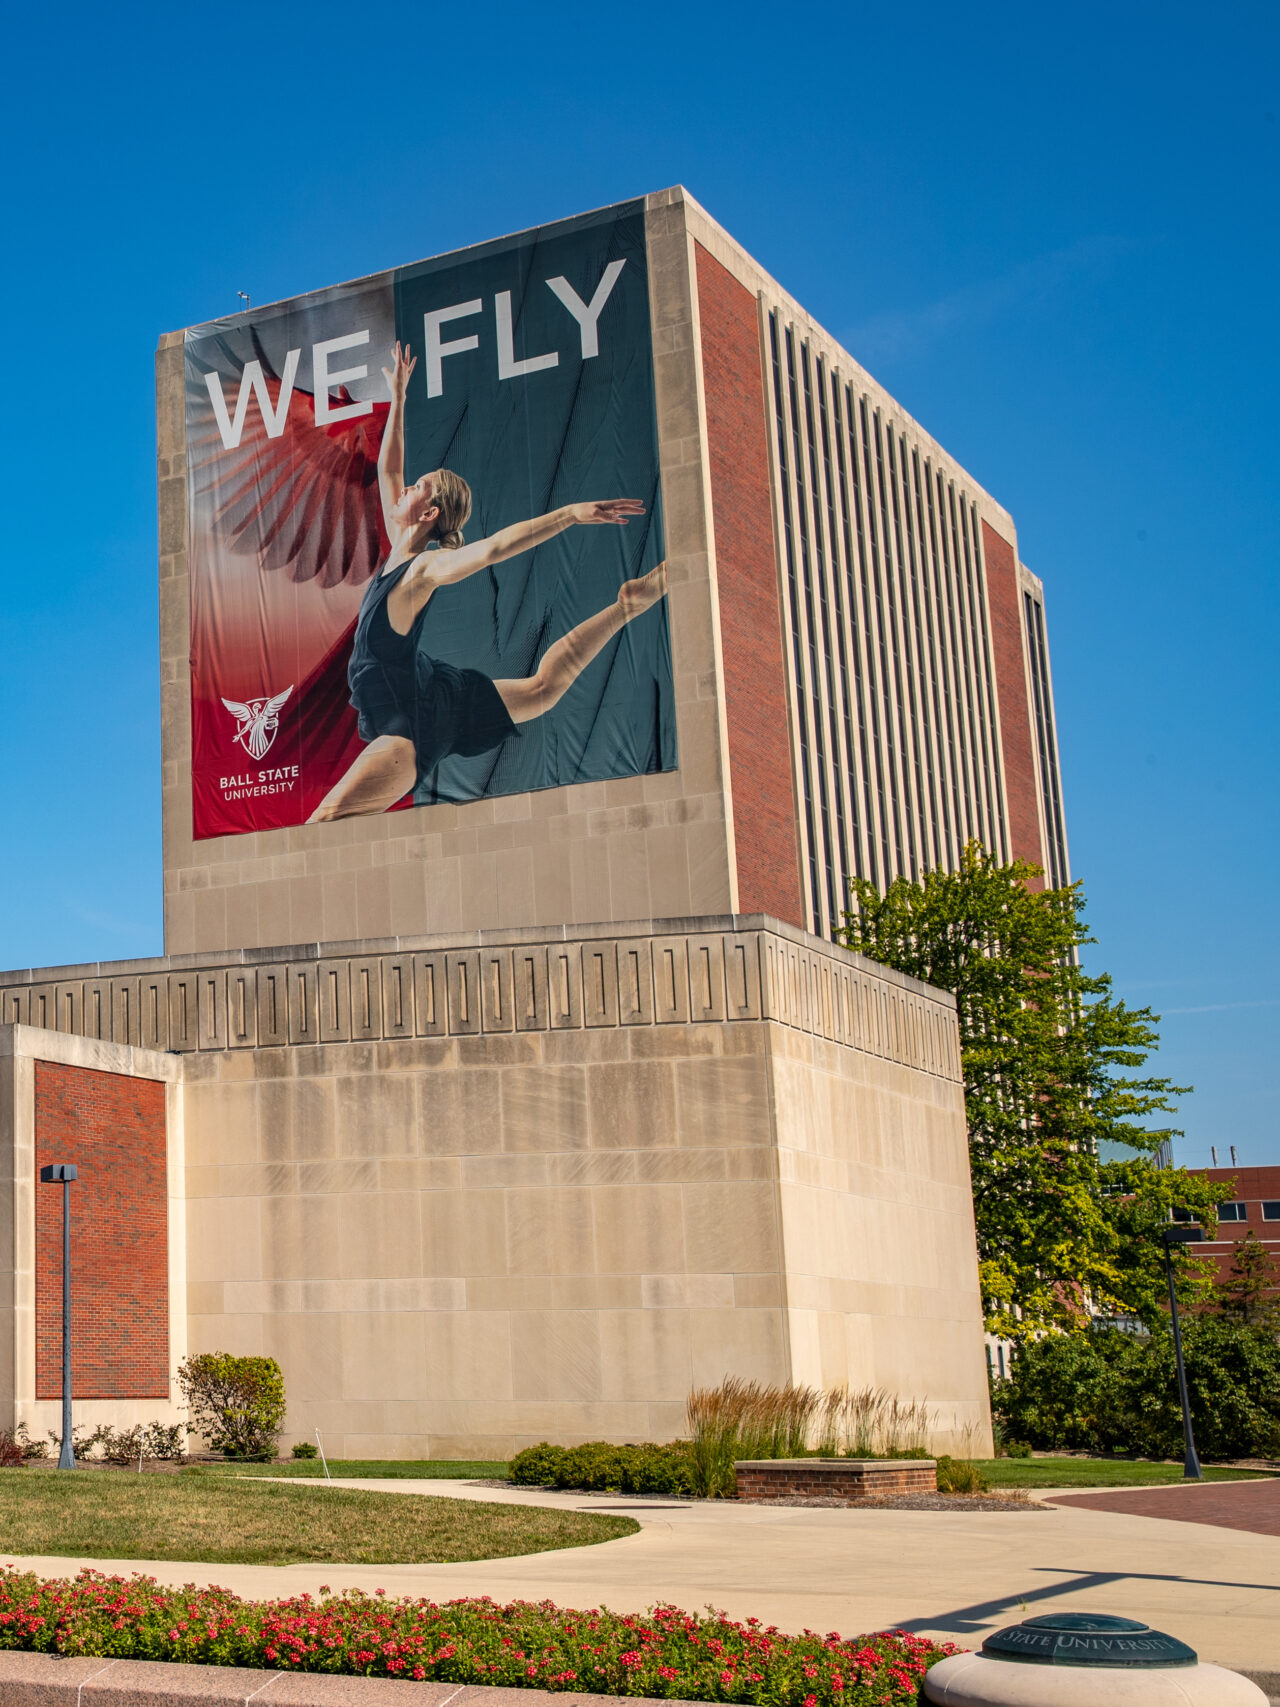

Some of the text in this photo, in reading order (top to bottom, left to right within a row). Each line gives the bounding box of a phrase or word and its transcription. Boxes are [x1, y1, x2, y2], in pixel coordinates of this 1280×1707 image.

[203, 258, 628, 451] WE FLY
[219, 765, 299, 789] BALL STATE
[224, 781, 295, 801] UNIVERSITY
[1003, 1630, 1052, 1646] STATE
[1057, 1634, 1176, 1650] UNIVERSITY
